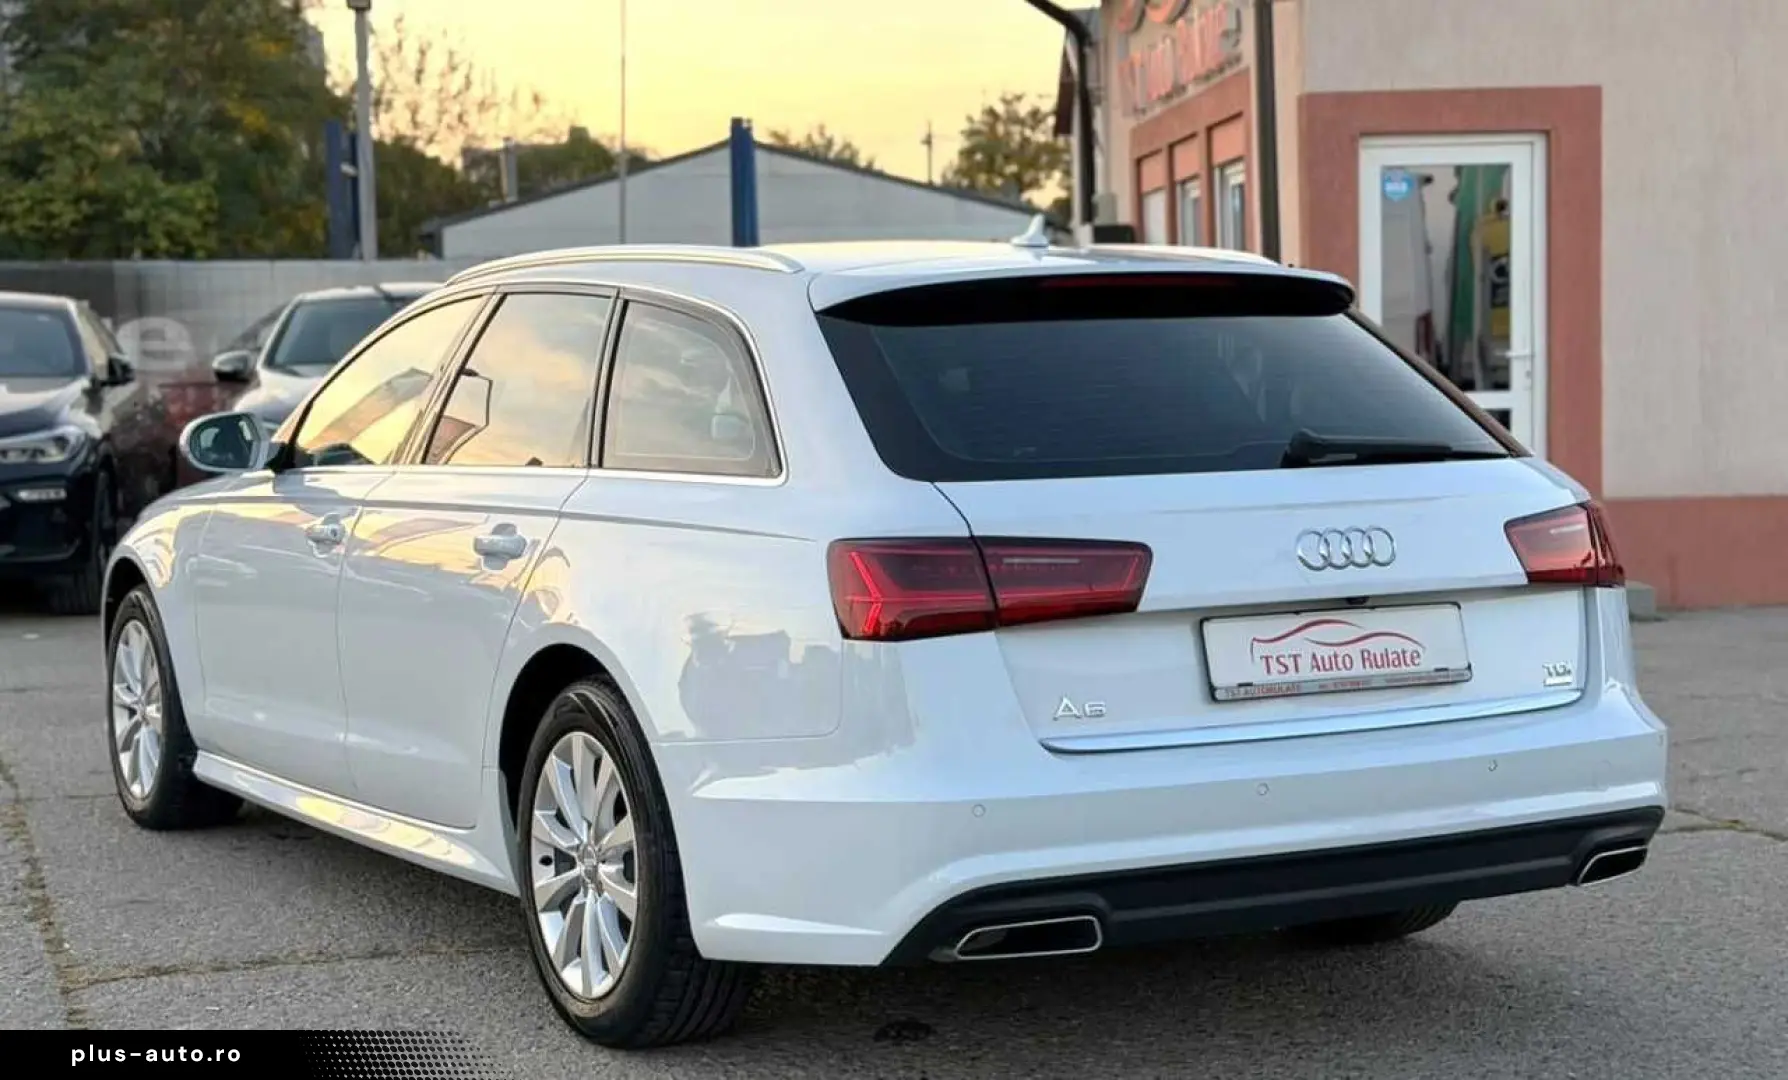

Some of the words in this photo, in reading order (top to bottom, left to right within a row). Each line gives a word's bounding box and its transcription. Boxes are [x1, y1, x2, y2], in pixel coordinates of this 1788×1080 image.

[1260, 653, 1302, 675] TST
[1310, 651, 1353, 673] Auto
[1361, 648, 1421, 670] Rulate
[1053, 697, 1106, 720] A6
